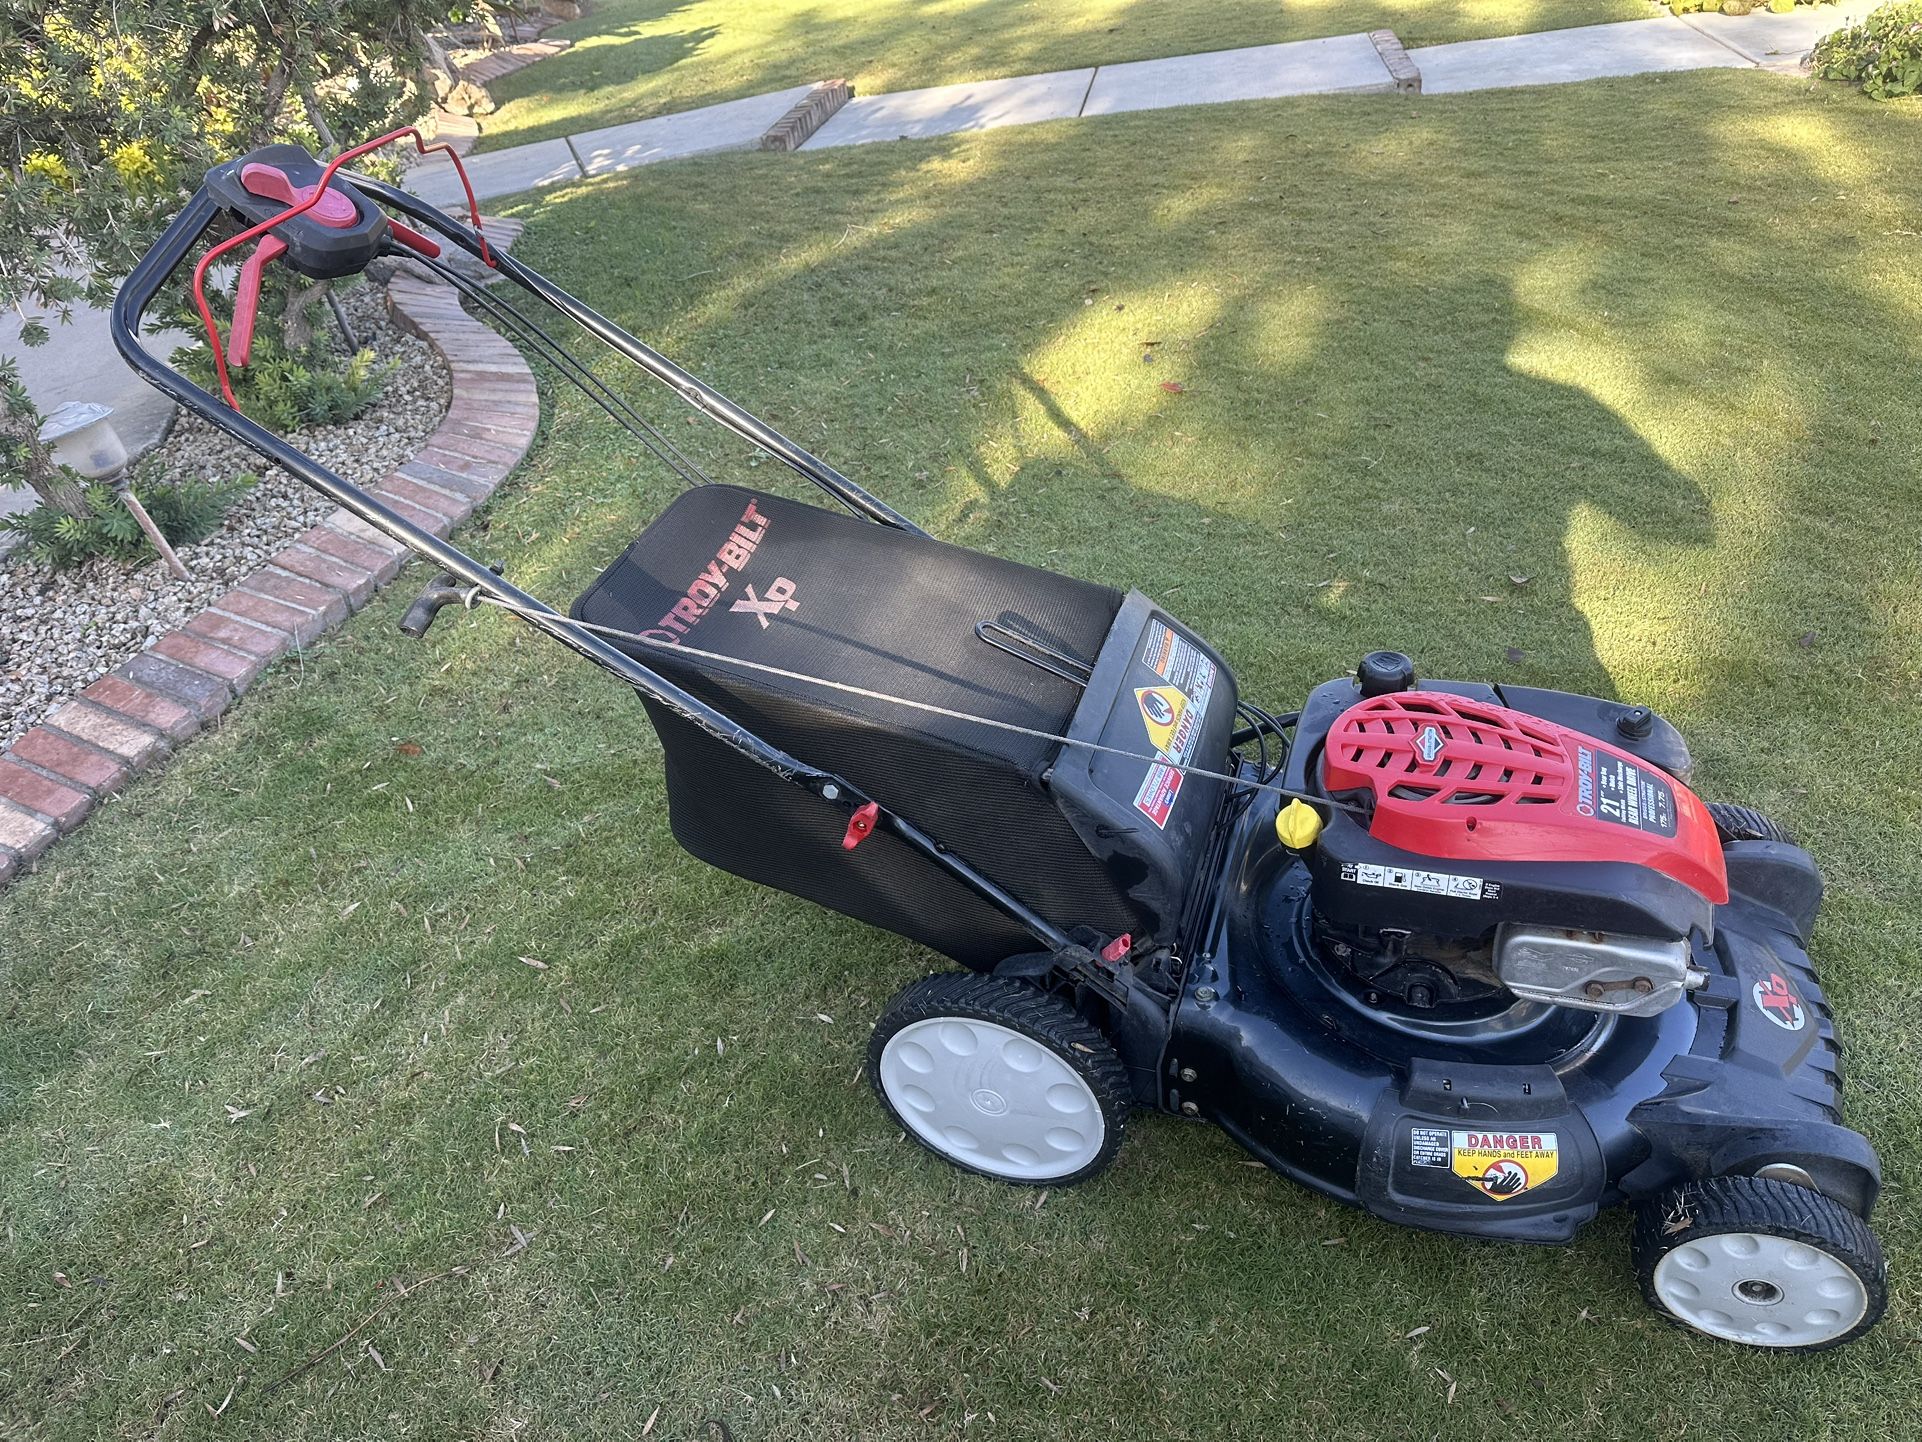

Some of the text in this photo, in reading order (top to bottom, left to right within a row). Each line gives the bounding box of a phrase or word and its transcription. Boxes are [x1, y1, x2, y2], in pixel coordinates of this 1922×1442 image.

[658, 501, 771, 634] TROY-BILT
[1173, 709, 1194, 754] DANGER
[1578, 745, 1593, 805] TROY-BILT
[1625, 766, 1639, 825] REAR WHEEL DRIVE
[1646, 783, 1656, 823] PROFESSIONAL
[1457, 1149, 1554, 1159] KEEP HANDS and FEET AWAY
[1467, 1134, 1543, 1149] DANGER
